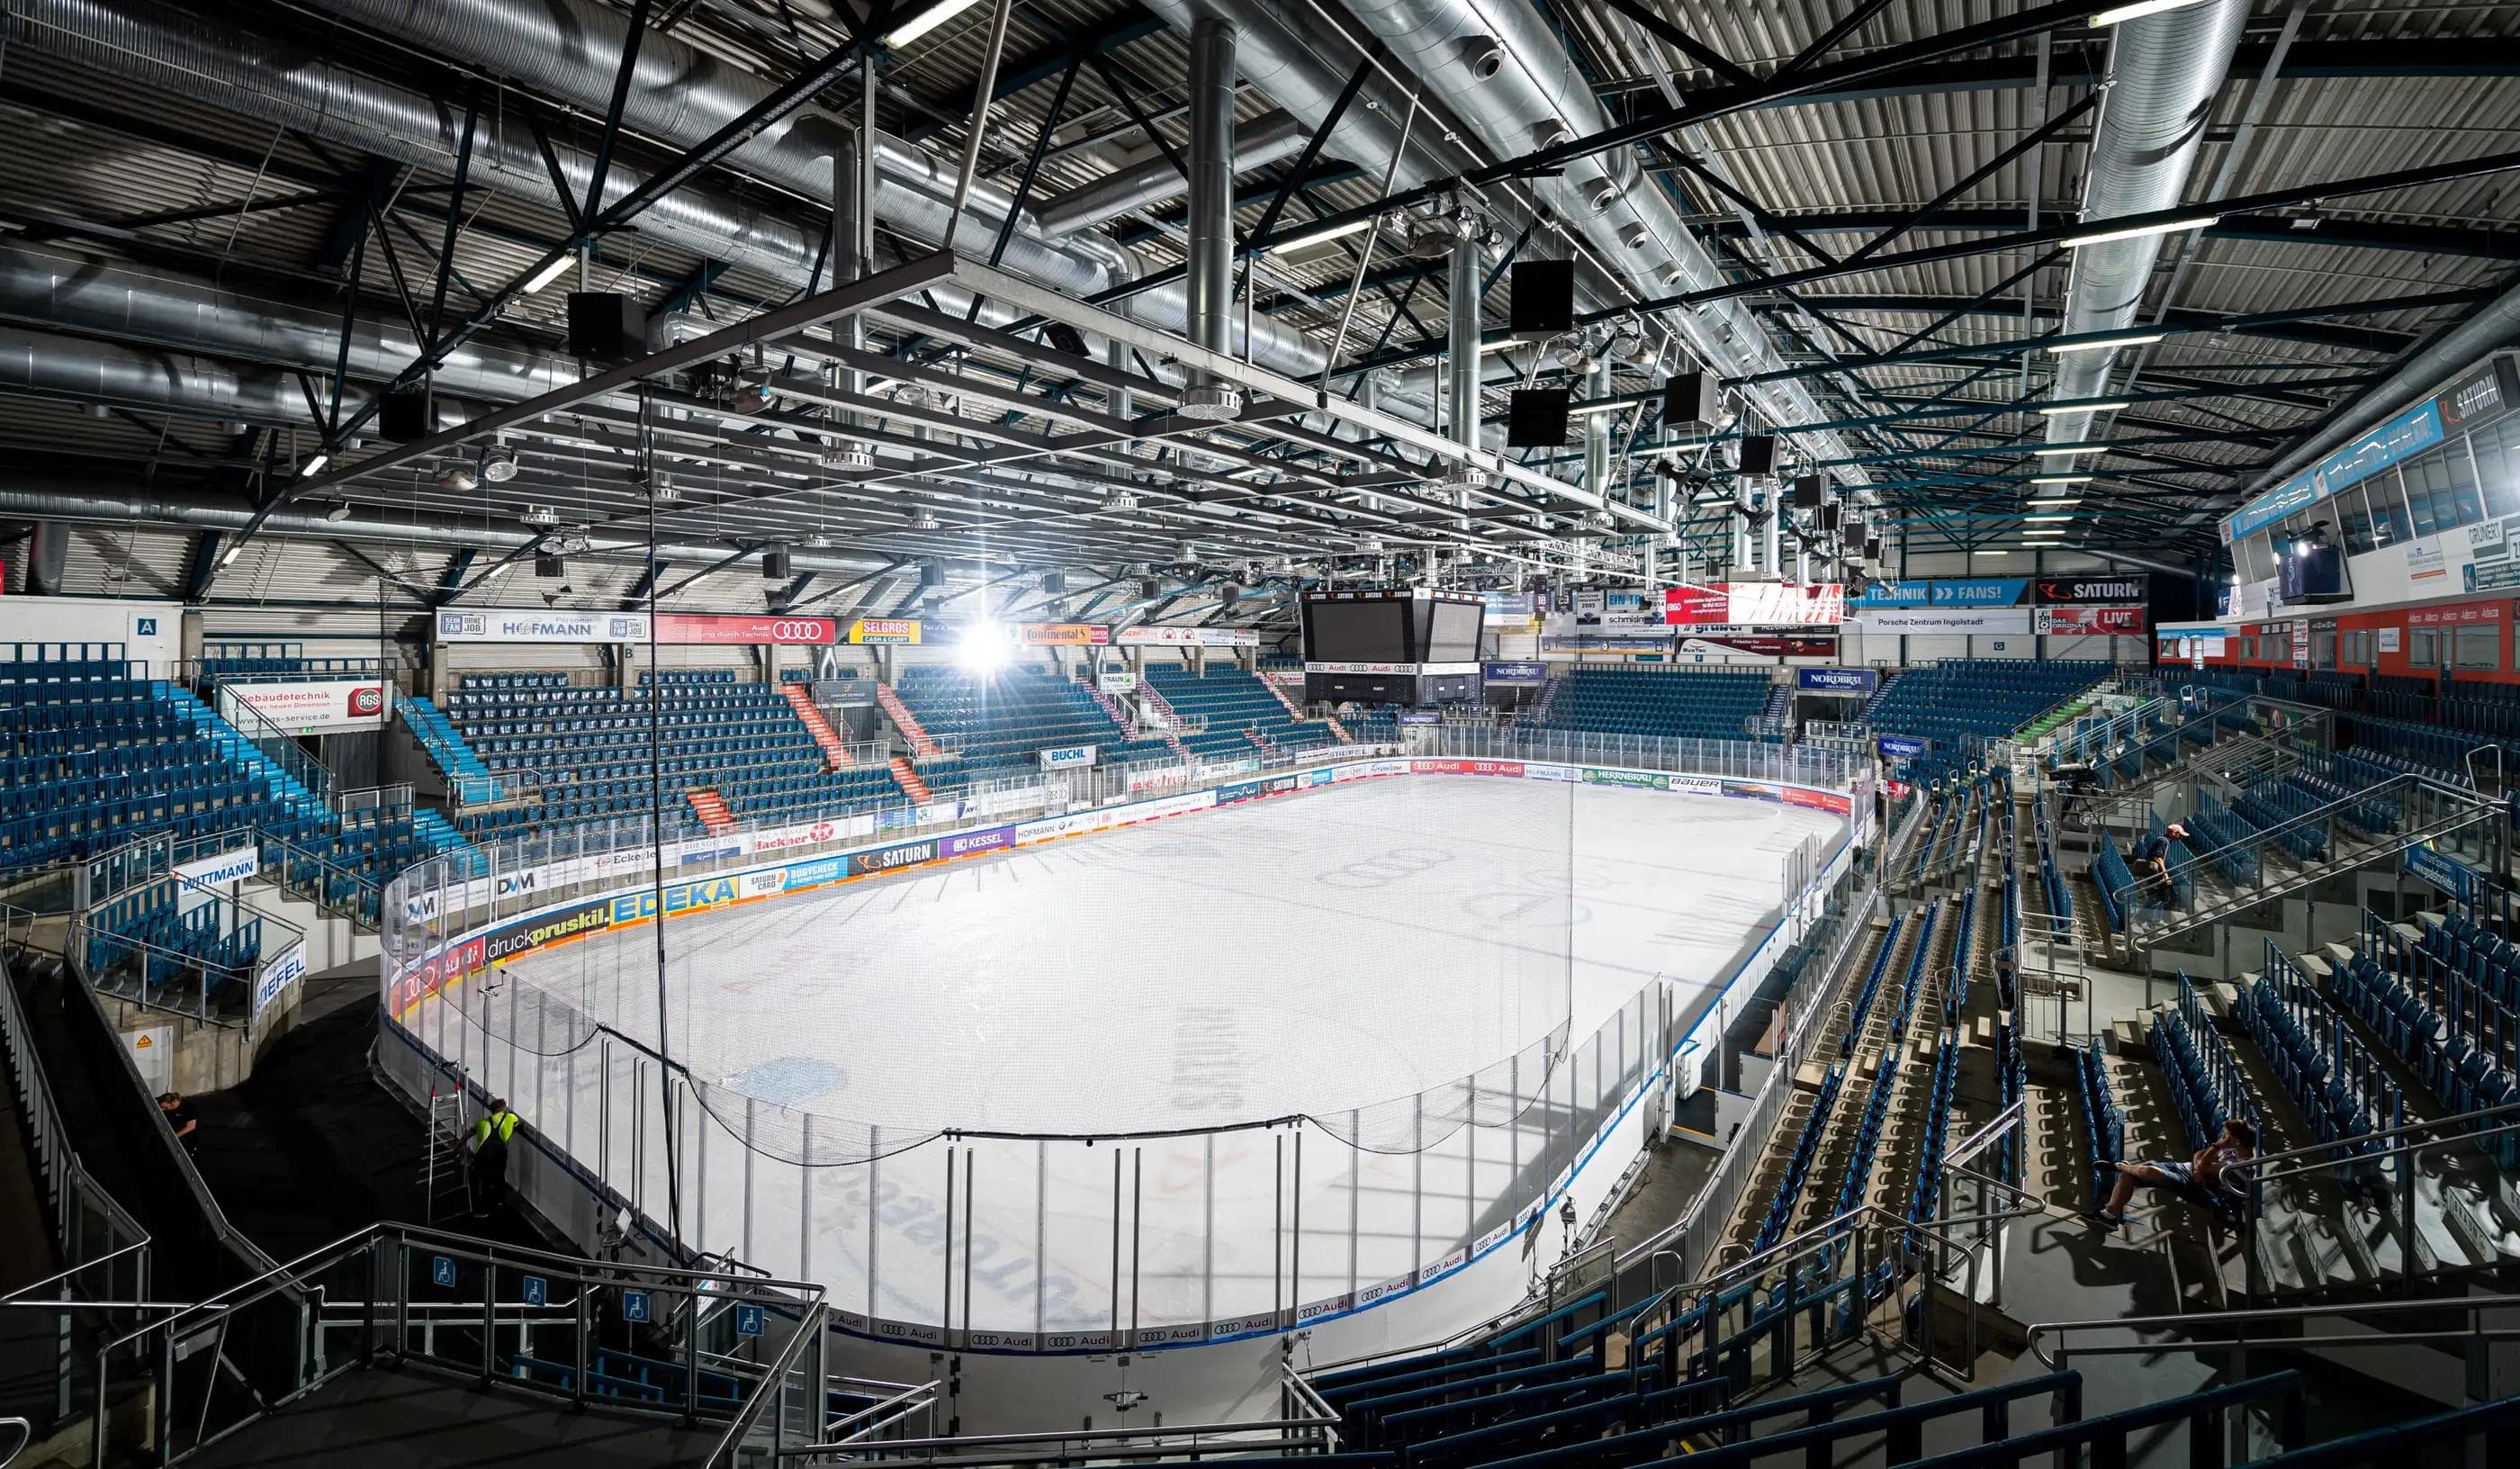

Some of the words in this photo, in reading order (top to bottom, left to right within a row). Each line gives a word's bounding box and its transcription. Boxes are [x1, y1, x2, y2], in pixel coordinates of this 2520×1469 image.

[2457, 374, 2498, 419] SATURN
[1958, 587, 2001, 599] FANS!
[2074, 582, 2138, 598] SATURN
[1538, 596, 1546, 605] 18
[1609, 595, 1625, 605] EIN
[1667, 603, 1681, 611] ERGO
[1943, 618, 1984, 626] Ingolstadt
[2104, 611, 2132, 624] LIVE
[140, 621, 153, 634] A
[863, 622, 908, 633] SELGROS
[1027, 630, 1078, 640] Continental
[1994, 642, 2004, 650] G
[625, 648, 634, 659] B
[1372, 664, 1390, 672] Audi
[239, 692, 330, 702] Gebäudetechnik
[360, 695, 380, 707] RGS
[238, 714, 330, 725] www.gs-service.de
[965, 806, 978, 814] AVI
[1018, 825, 1055, 838] HOFMANN
[968, 833, 1003, 848] KESSEL
[614, 852, 656, 864] Eckele
[883, 845, 931, 867] SATURN
[183, 861, 254, 891] WITTMANN
[751, 874, 776, 885] SATURN
[497, 872, 535, 895] DVM
[758, 882, 776, 890] CARD
[408, 896, 436, 917] VM
[615, 879, 734, 923] EDEKA
[488, 907, 610, 960] druckpruskil.
[1492, 1227, 1508, 1242] Audi
[1444, 1255, 1462, 1270] Audi
[1386, 1278, 1408, 1293] Audi
[1323, 1299, 1348, 1312] Audi
[838, 1315, 861, 1328] Audi
[1246, 1318, 1273, 1329] Audi
[910, 1328, 936, 1339] Audi
[1172, 1329, 1200, 1340] Audi
[1004, 1338, 1031, 1347] Audi
[1081, 1336, 1110, 1346] Audi
